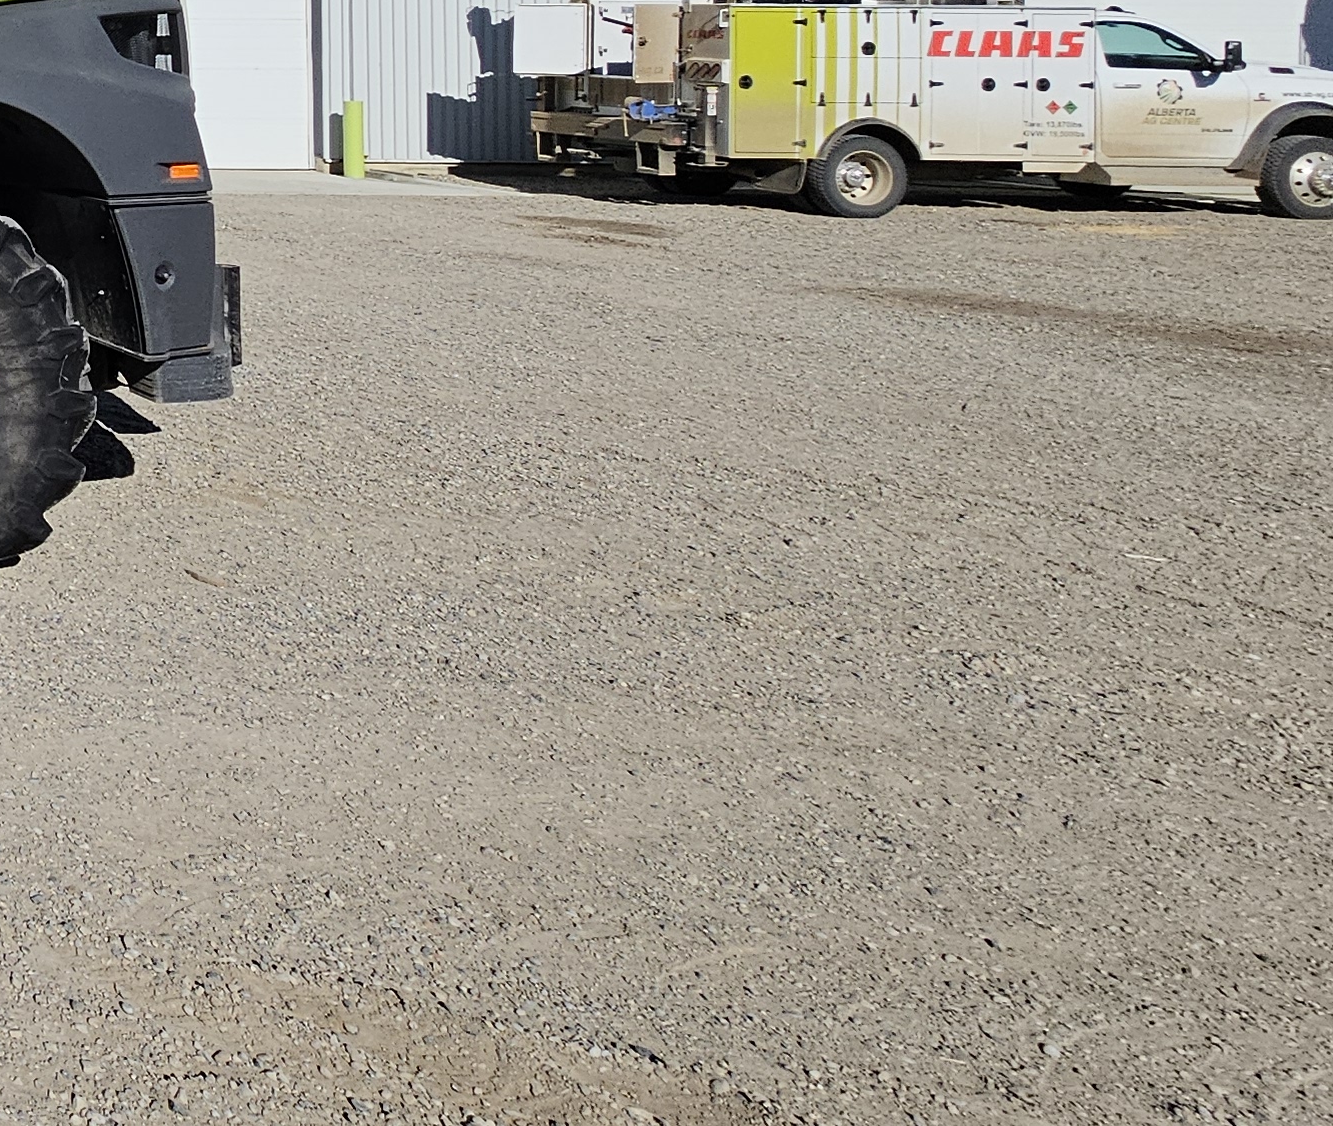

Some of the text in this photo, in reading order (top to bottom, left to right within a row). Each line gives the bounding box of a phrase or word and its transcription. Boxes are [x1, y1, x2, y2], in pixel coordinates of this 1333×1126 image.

[926, 30, 1086, 58] CLAAS
[1146, 107, 1197, 117] ALBERTA
[1141, 116, 1203, 126] AG CENTRE
